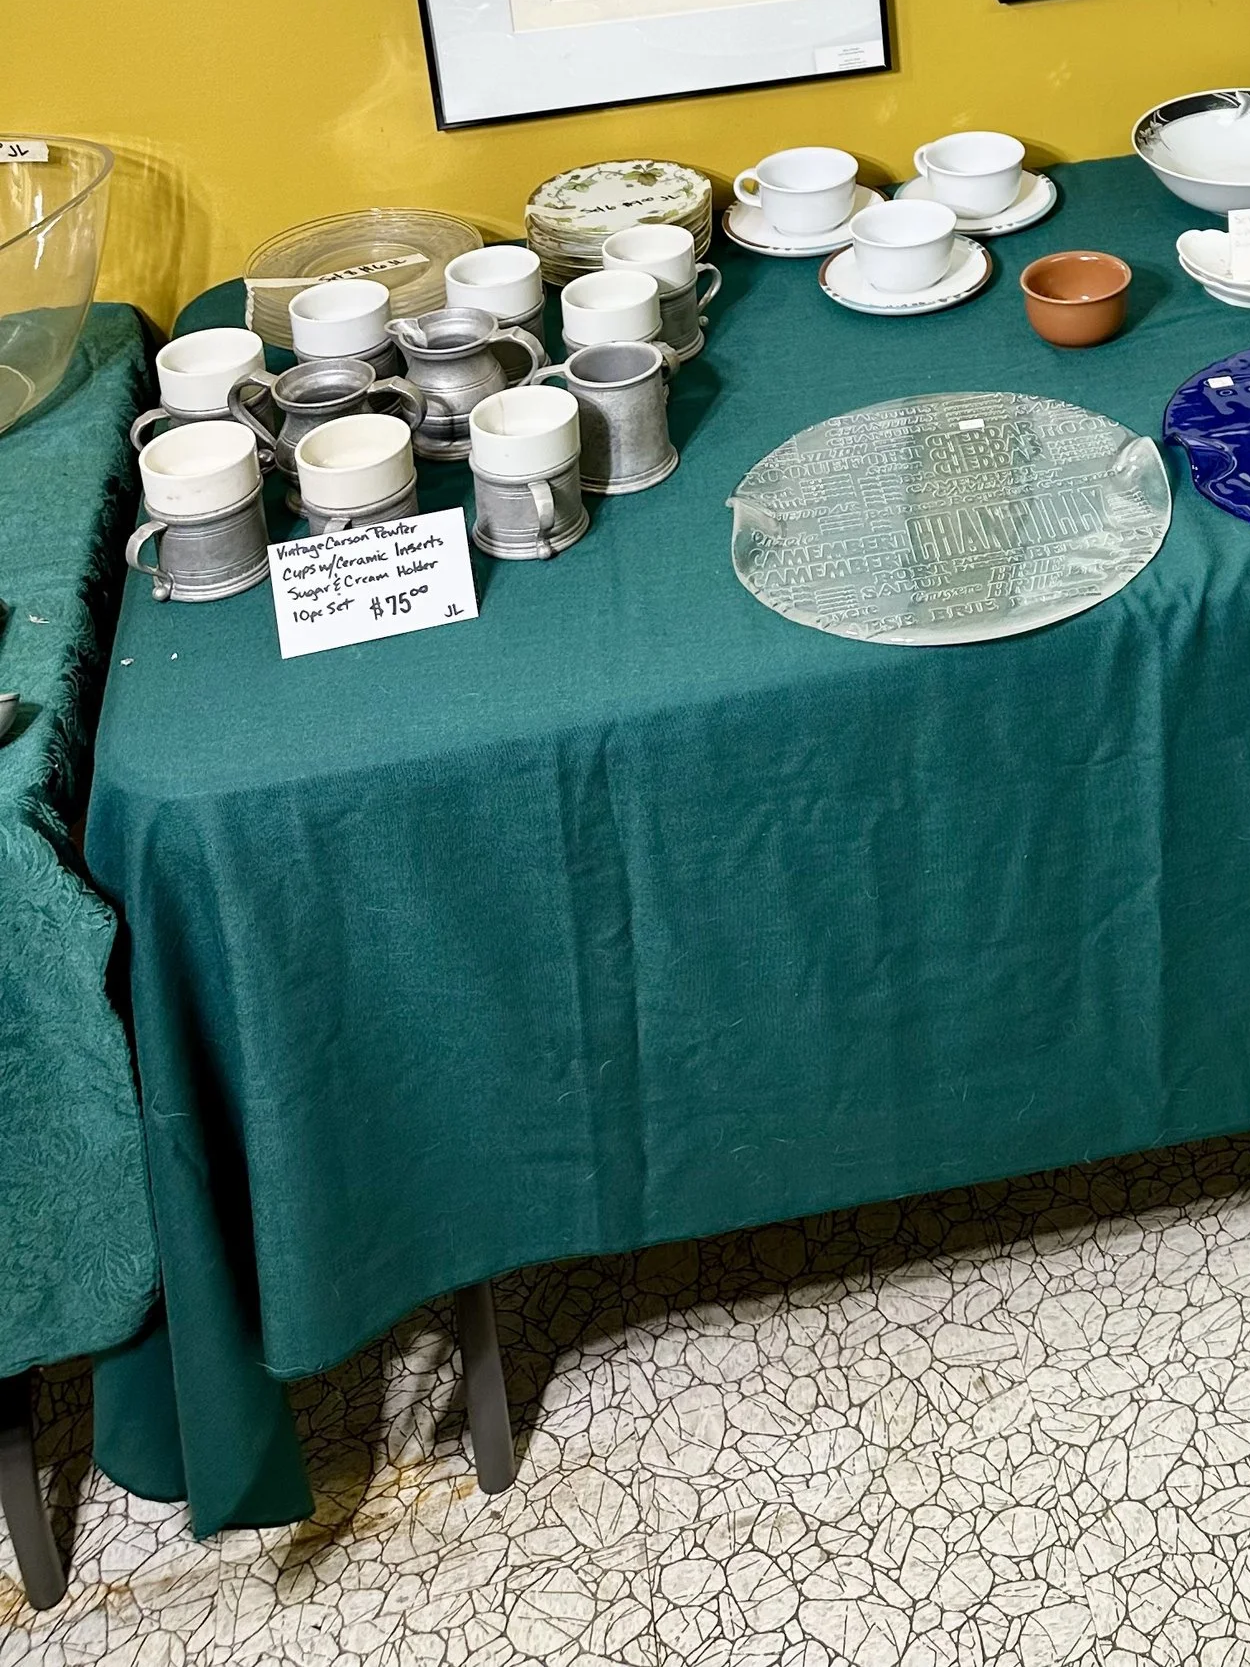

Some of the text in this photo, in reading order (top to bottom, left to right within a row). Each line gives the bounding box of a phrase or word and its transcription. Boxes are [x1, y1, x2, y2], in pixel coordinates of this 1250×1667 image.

[8, 144, 29, 158] JL
[579, 205, 606, 214] Set
[276, 521, 418, 561] Vintage Carson Pewter
[904, 484, 1112, 566] CHANTILLY
[282, 563, 317, 582] Cups
[394, 534, 444, 557] Inserts
[747, 547, 913, 589] CAMEMBERT
[750, 529, 908, 569] CAMEMBERT
[287, 584, 331, 602] Sugar
[344, 572, 390, 588] Cream
[396, 559, 439, 578] Holder
[326, 597, 356, 615] Set
[443, 603, 465, 618] JL
